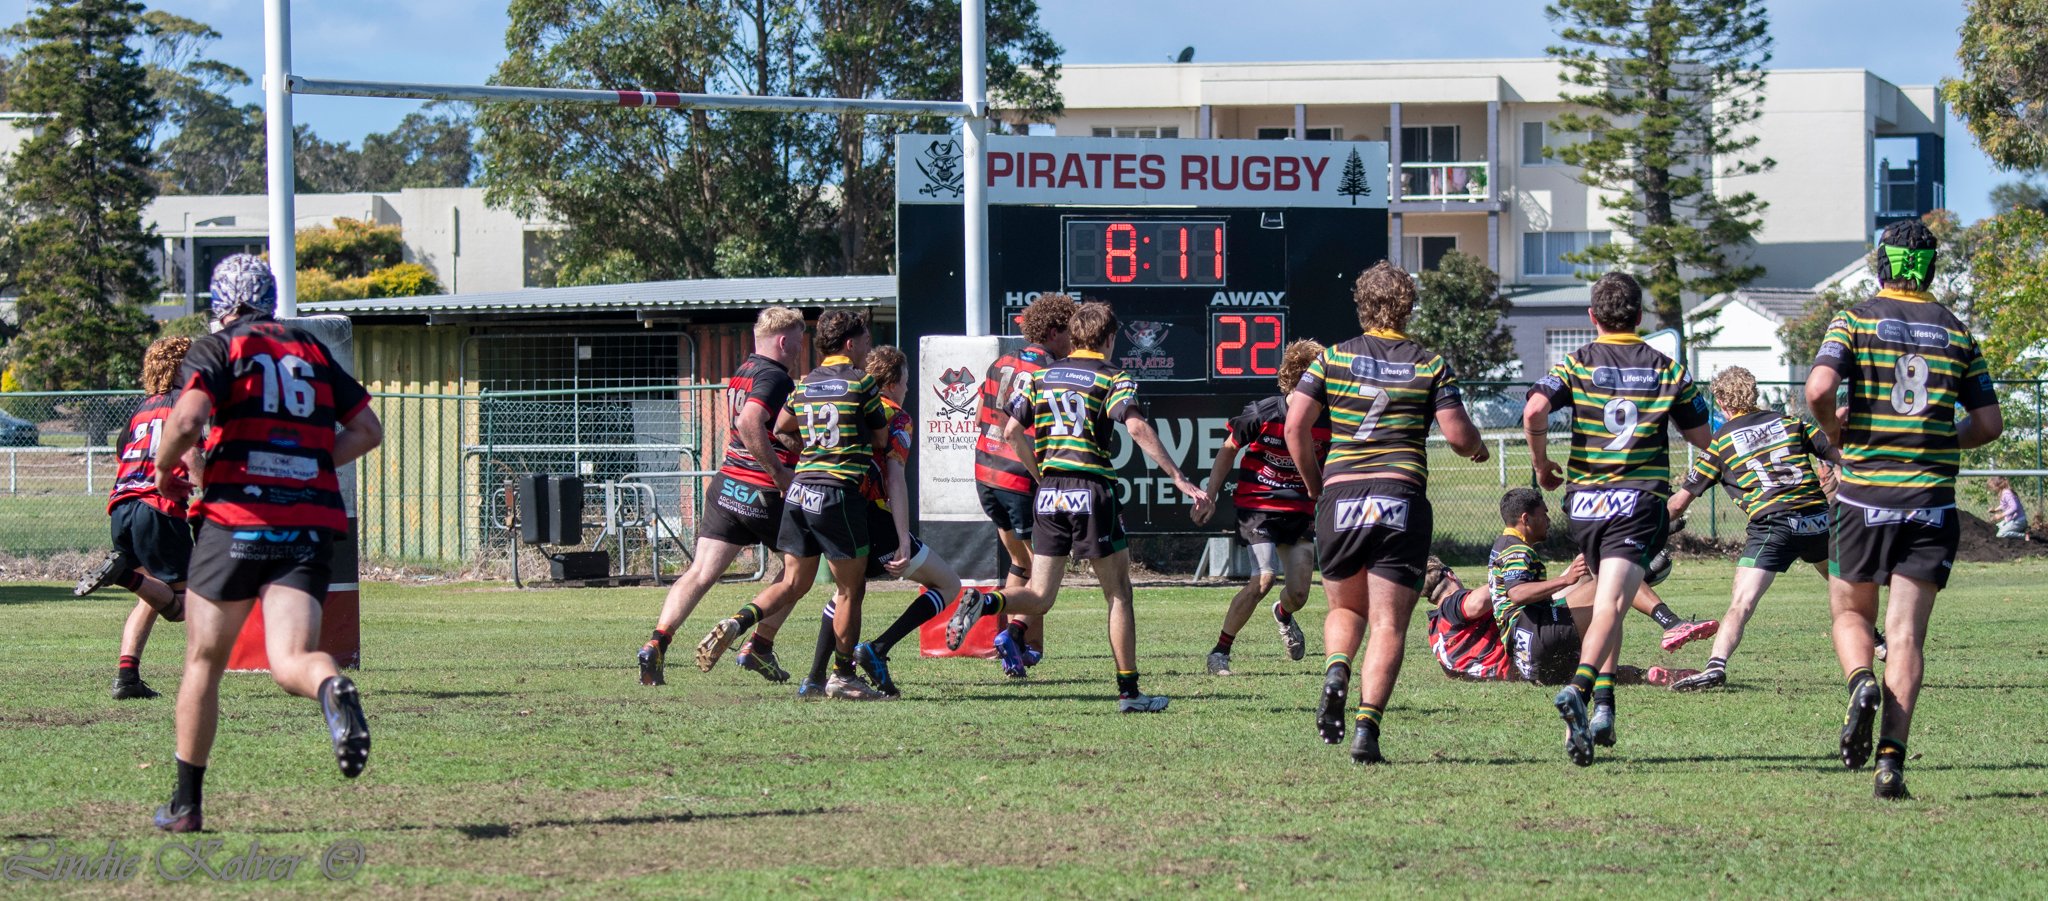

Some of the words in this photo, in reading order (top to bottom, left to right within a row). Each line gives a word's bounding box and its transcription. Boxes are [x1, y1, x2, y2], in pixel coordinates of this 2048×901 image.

[987, 151, 1166, 189] PIRATES
[1180, 155, 1330, 192] RUGBY
[1006, 291, 1082, 306] HOE
[1210, 291, 1286, 306] AWAY
[1216, 316, 1281, 375] 22
[251, 353, 316, 418] 16
[1890, 353, 1929, 415] 8
[803, 402, 840, 448] 13
[927, 420, 982, 435] PIRATE
[1043, 389, 1087, 437] 19
[1353, 385, 1391, 441] 7
[1603, 398, 1638, 451] 9
[122, 418, 163, 460] 21
[927, 436, 946, 445] PORT
[949, 436, 977, 444] MACQUA
[1264, 452, 1295, 466] TOORM
[1746, 447, 1804, 493] 15
[717, 500, 738, 513] WINDOW
[737, 507, 769, 519] SOLUTIONS
[719, 495, 768, 515] ARCHITECTURAL
[229, 551, 267, 560] WINDOW
[231, 542, 312, 554] ARCHITECTURA
